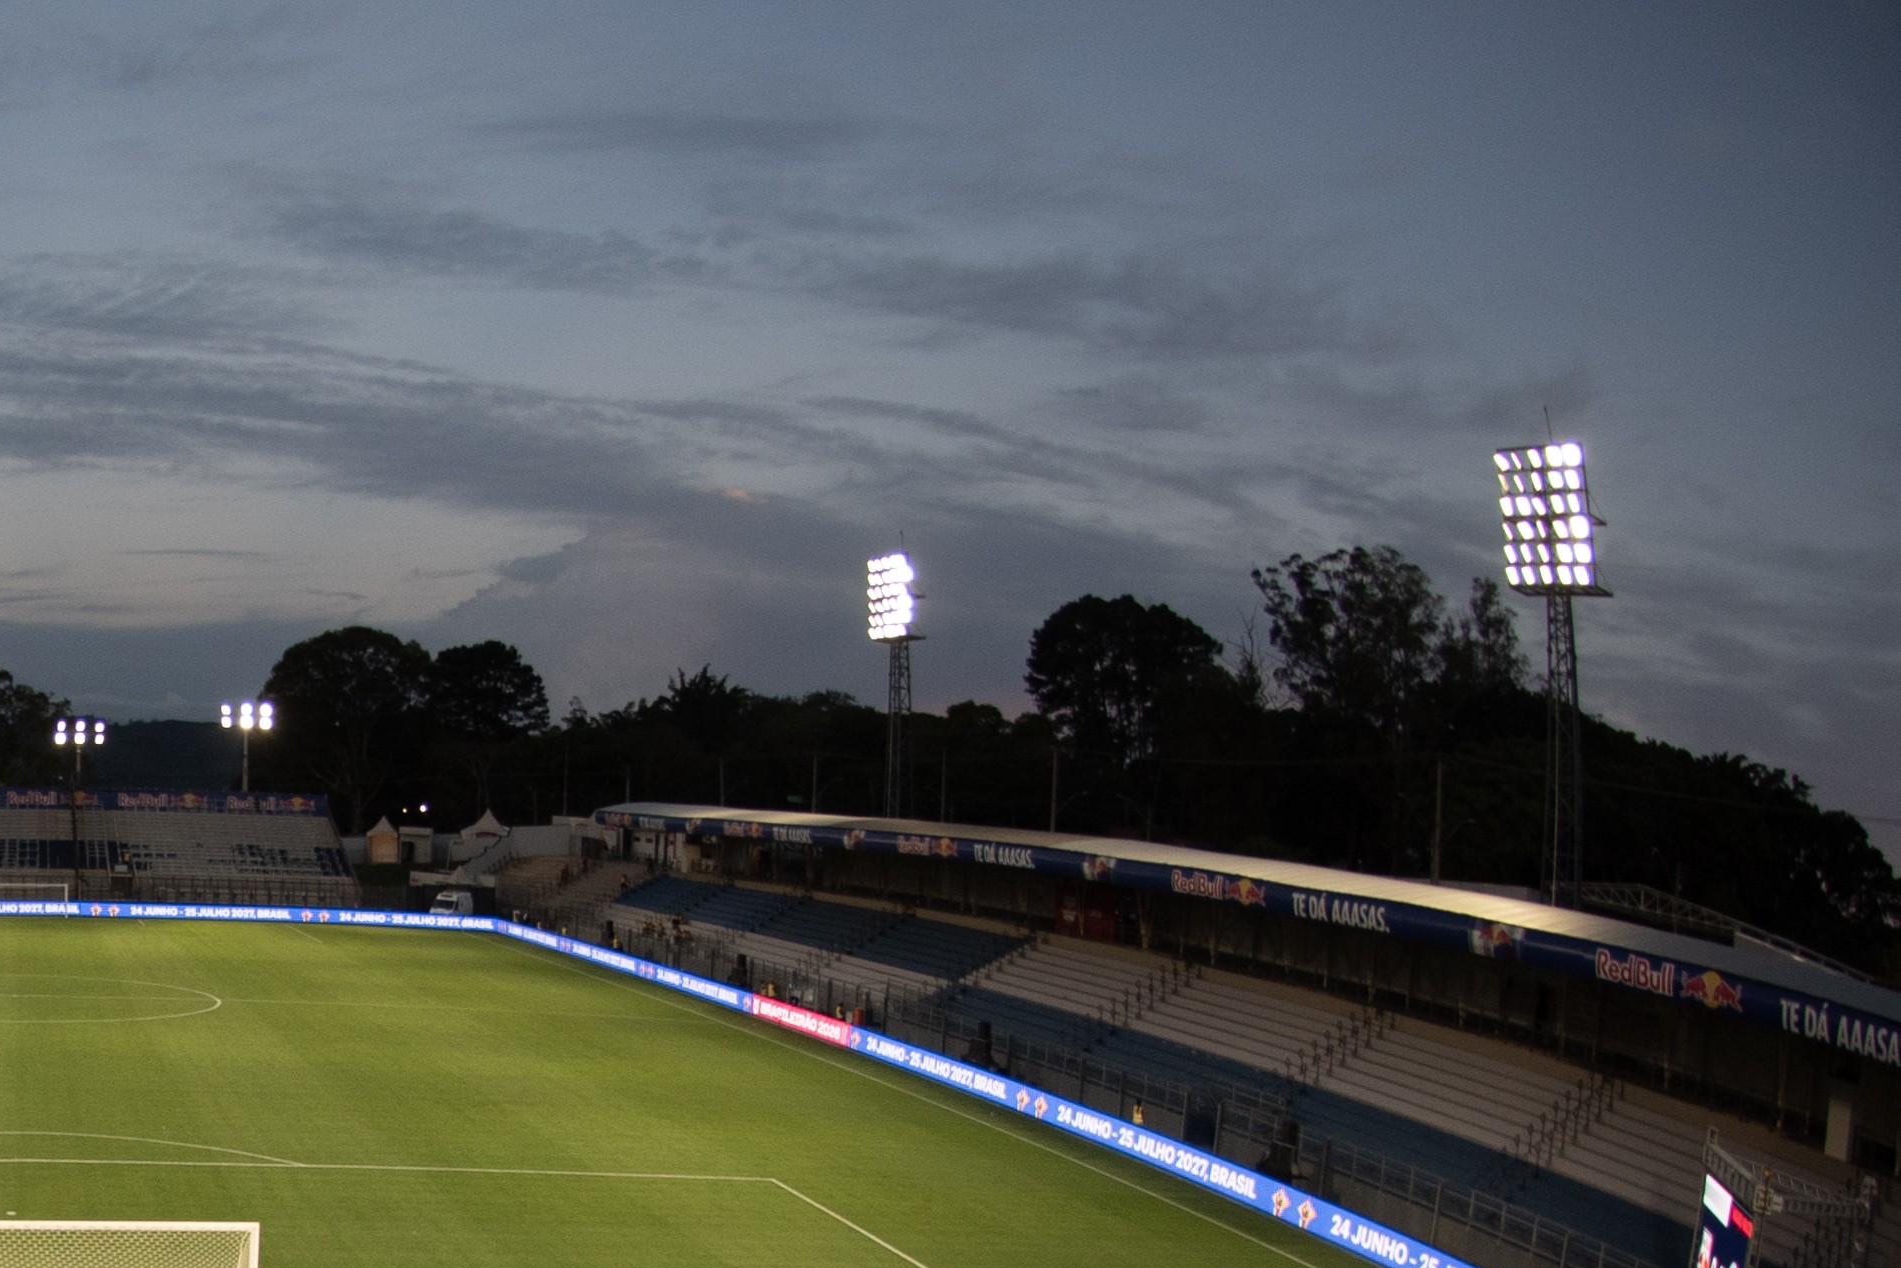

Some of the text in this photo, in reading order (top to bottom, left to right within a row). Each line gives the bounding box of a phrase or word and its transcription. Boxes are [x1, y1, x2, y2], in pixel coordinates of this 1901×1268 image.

[1292, 892, 1306, 917] TE
[1309, 893, 1327, 922] DÁ
[1332, 899, 1390, 933] AAASAS.
[1780, 998, 1800, 1034] TE
[1804, 1002, 1830, 1044] DÁ
[866, 1036, 878, 1051] 24
[875, 1041, 905, 1062] JUNHO
[909, 1051, 921, 1068] 25
[921, 1055, 950, 1077] JULHO
[974, 1075, 1006, 1099] BRASIL
[1057, 1104, 1072, 1123] 24
[1069, 1112, 1112, 1140] JUNHO
[1118, 1128, 1134, 1149] 25
[1134, 1134, 1175, 1164] JULHO
[1176, 1150, 1208, 1182] 2027,
[1209, 1164, 1256, 1200] BRASIL
[1330, 1214, 1351, 1237] 24
[1351, 1225, 1408, 1265] JUNHO
